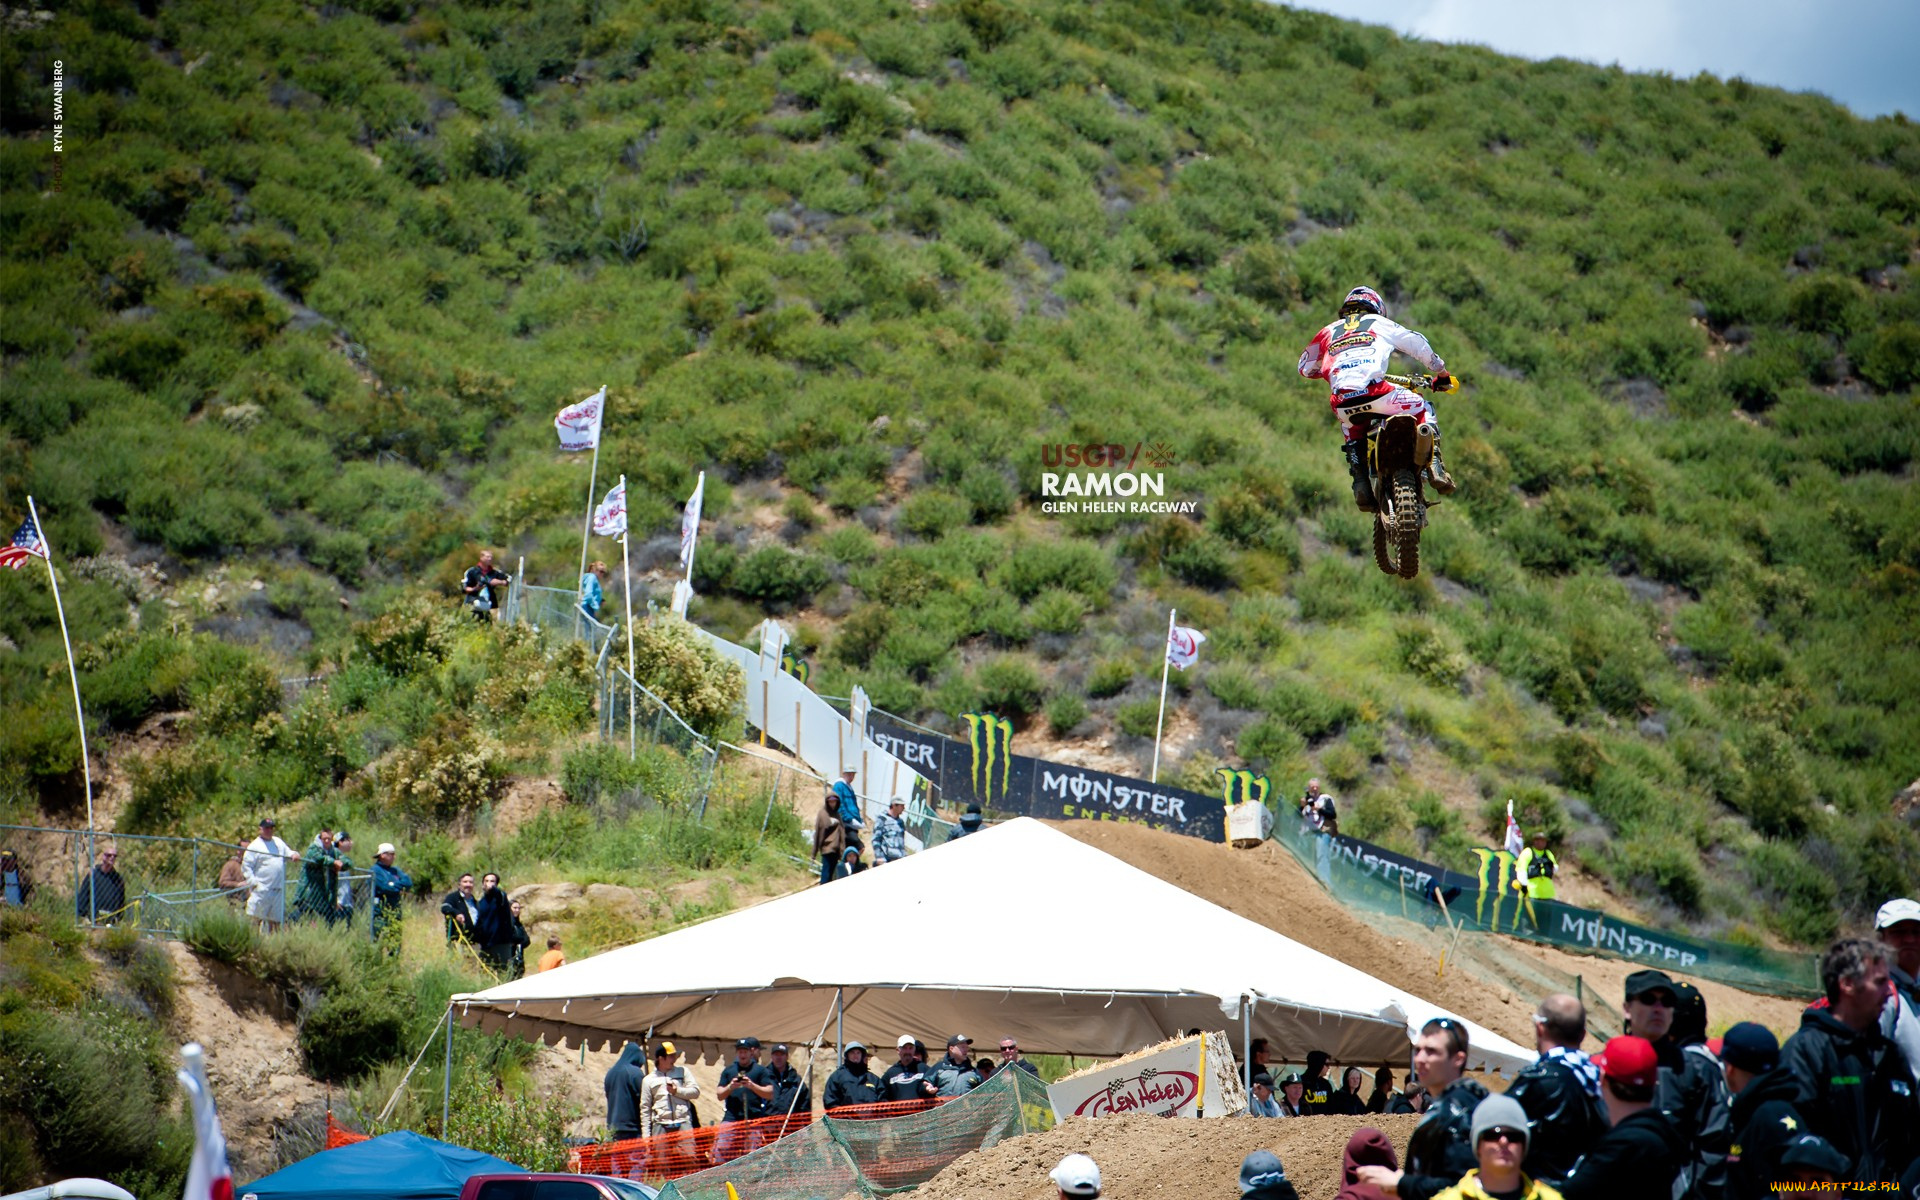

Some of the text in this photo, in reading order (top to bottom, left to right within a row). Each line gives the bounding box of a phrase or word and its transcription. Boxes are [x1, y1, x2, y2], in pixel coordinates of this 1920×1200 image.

[1042, 770, 1188, 823] MONSTER
[1329, 836, 1433, 892] ONSTER
[1093, 1089, 1138, 1117] GLEN
[1138, 1077, 1185, 1108] HELEN
